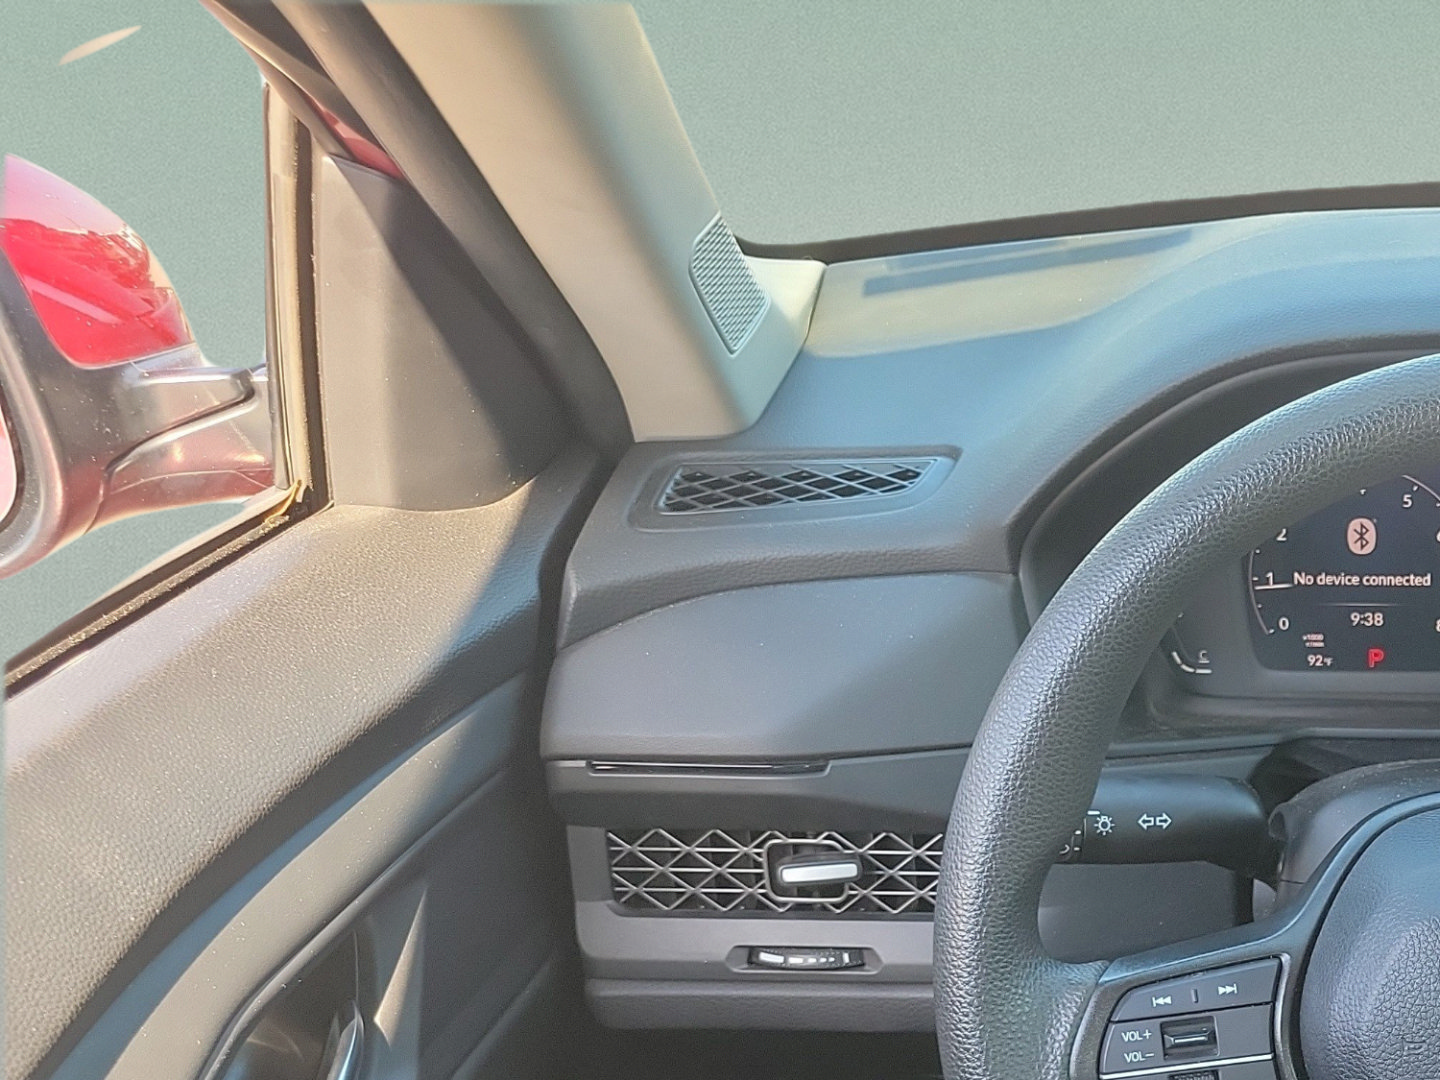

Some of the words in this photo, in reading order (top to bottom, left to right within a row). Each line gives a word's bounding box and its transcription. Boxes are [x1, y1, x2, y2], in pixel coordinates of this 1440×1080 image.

[1402, 495, 1412, 507] 5
[1265, 572, 1274, 586] 1
[1293, 572, 1313, 586] No
[1316, 572, 1361, 586] device
[1362, 572, 1431, 586] connected
[1278, 618, 1289, 631] 0
[1350, 613, 1384, 626] 9:38
[1368, 648, 1385, 668] P
